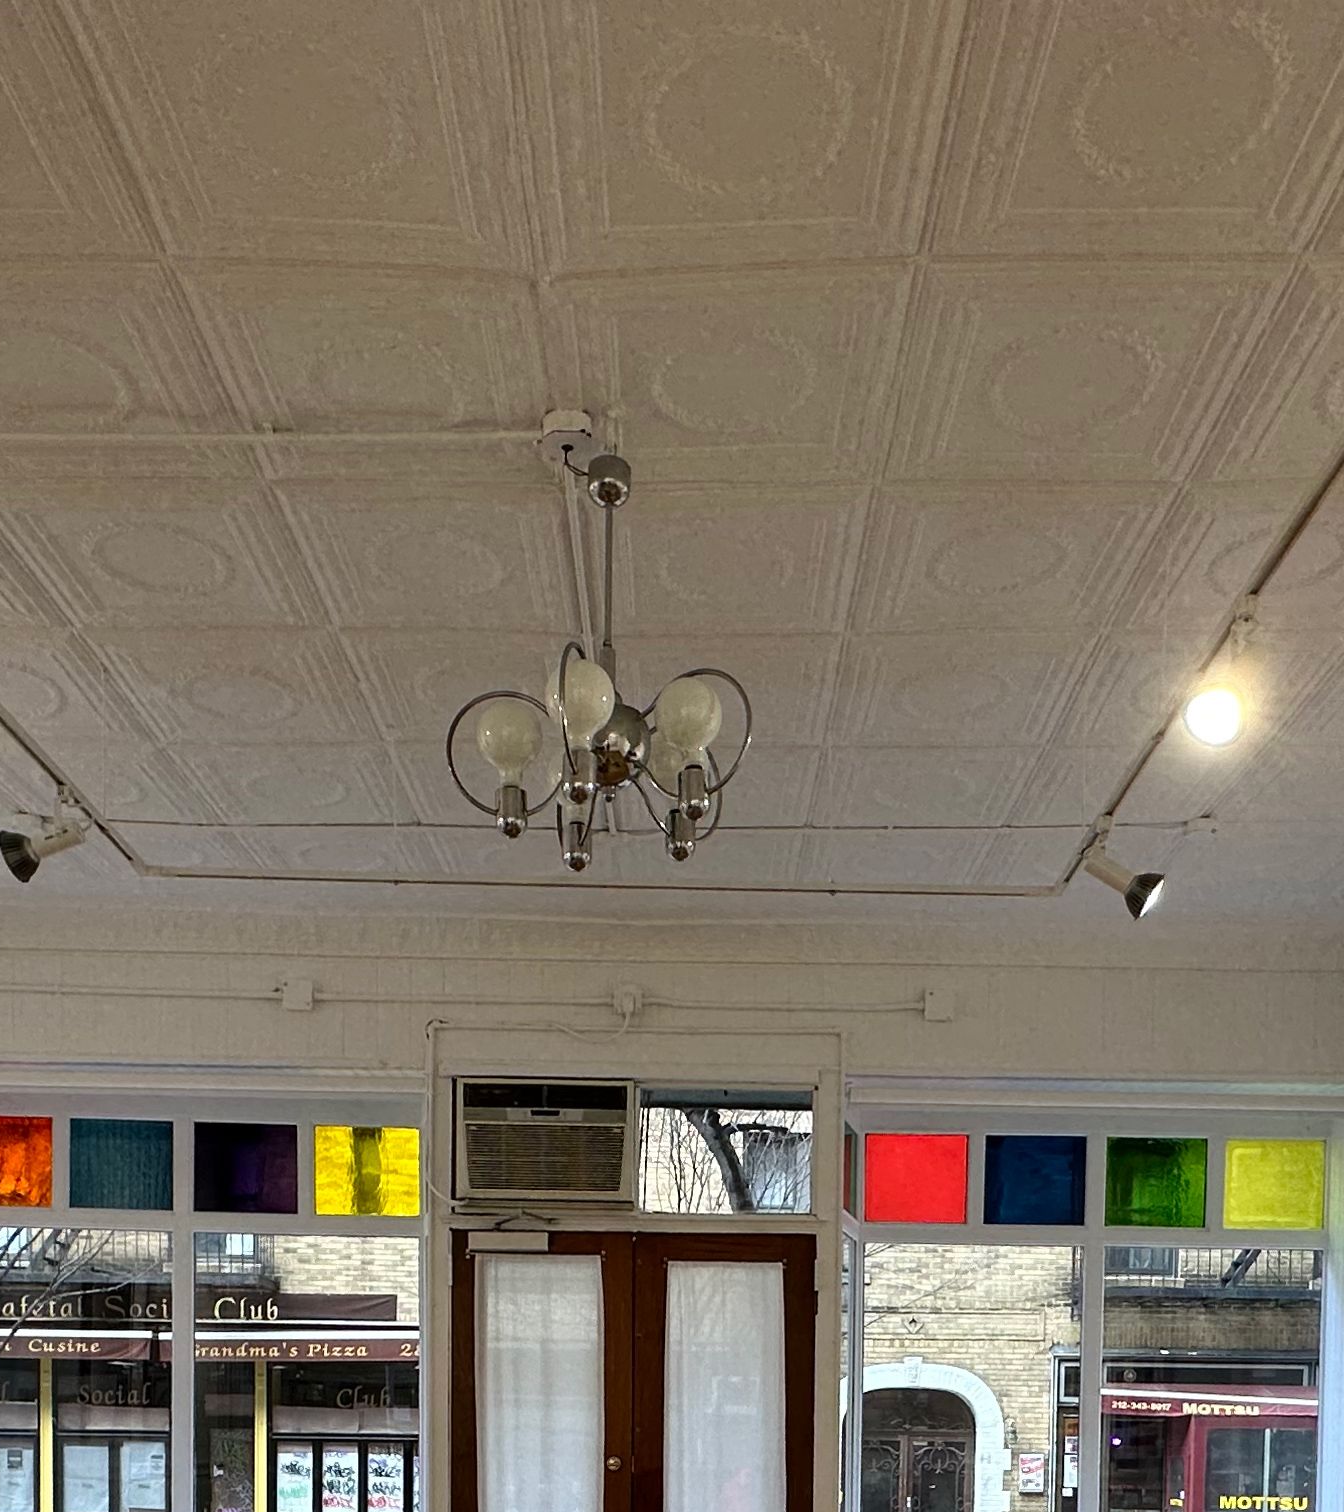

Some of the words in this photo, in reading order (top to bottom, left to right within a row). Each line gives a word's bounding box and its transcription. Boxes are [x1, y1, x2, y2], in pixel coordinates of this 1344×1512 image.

[104, 1295, 170, 1319] Soci
[214, 1296, 279, 1321] Club
[28, 1338, 102, 1353] Cusine
[306, 1343, 369, 1357] Pizza
[76, 1382, 151, 1406] Social
[336, 1385, 391, 1409] Club
[1183, 1402, 1260, 1416] MOTTSU
[1219, 1495, 1308, 1511] MOTTSU
